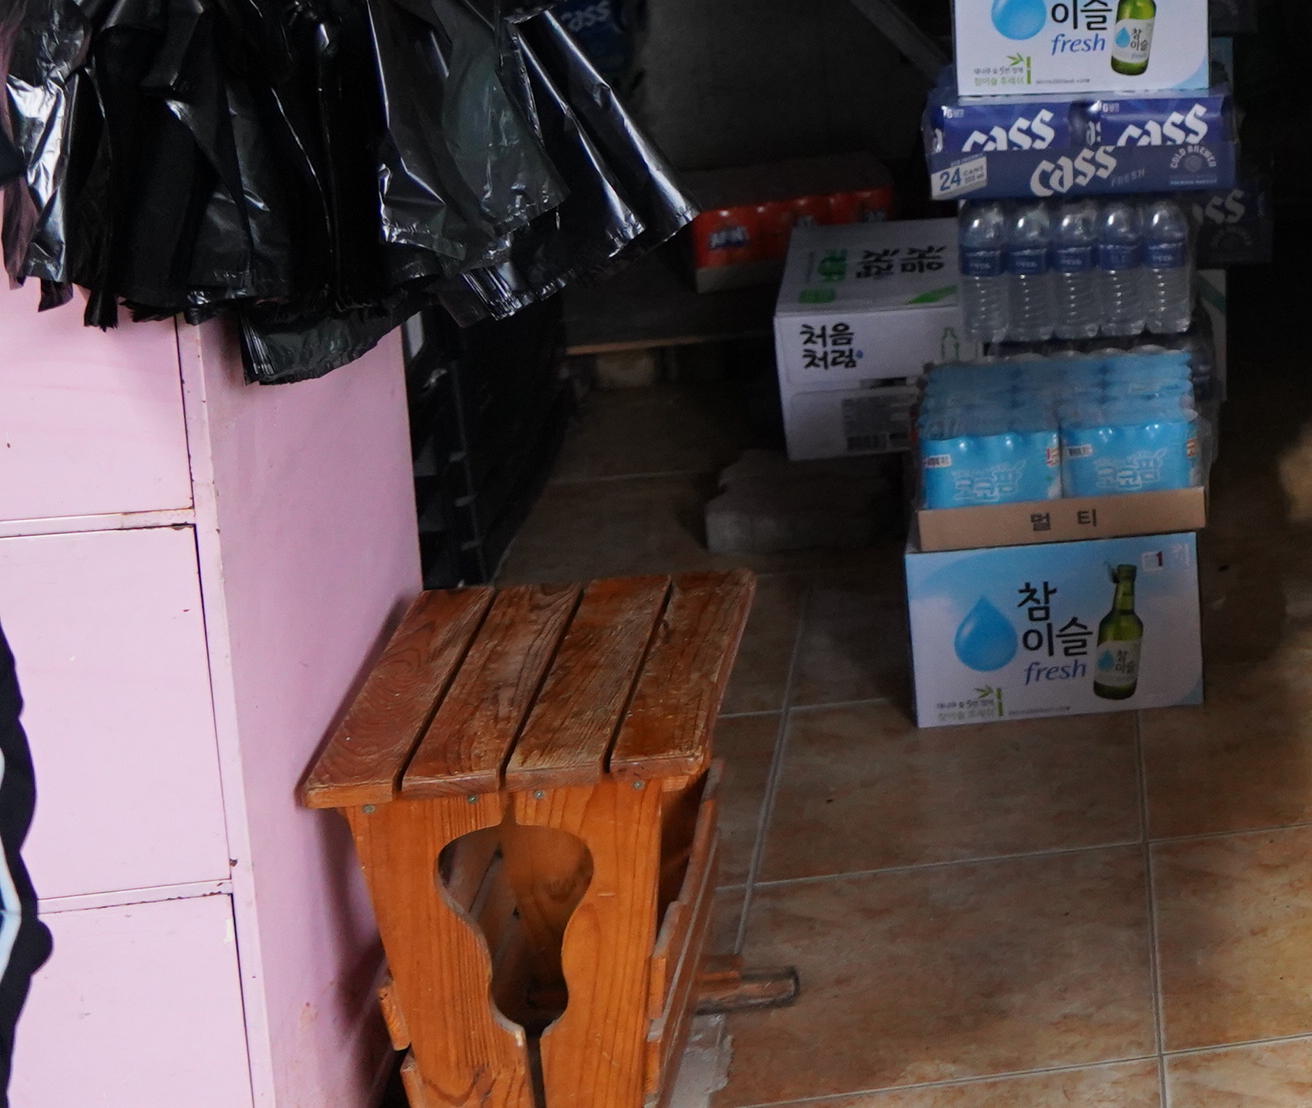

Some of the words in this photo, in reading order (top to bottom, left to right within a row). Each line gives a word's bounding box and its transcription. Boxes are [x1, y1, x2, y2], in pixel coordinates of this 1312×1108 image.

[1050, 33, 1106, 57] fresh
[1129, 37, 1149, 53] 이슬
[1131, 27, 1143, 41] 참
[939, 167, 961, 192] 24
[1029, 144, 1119, 199] CASS
[800, 322, 856, 349] 처음
[802, 347, 858, 371] 처럼
[1017, 580, 1058, 622] 참
[1021, 617, 1094, 658] 이슬
[1115, 646, 1128, 662] 참
[1024, 660, 1088, 685] fresh
[1114, 659, 1136, 676] 이슬
